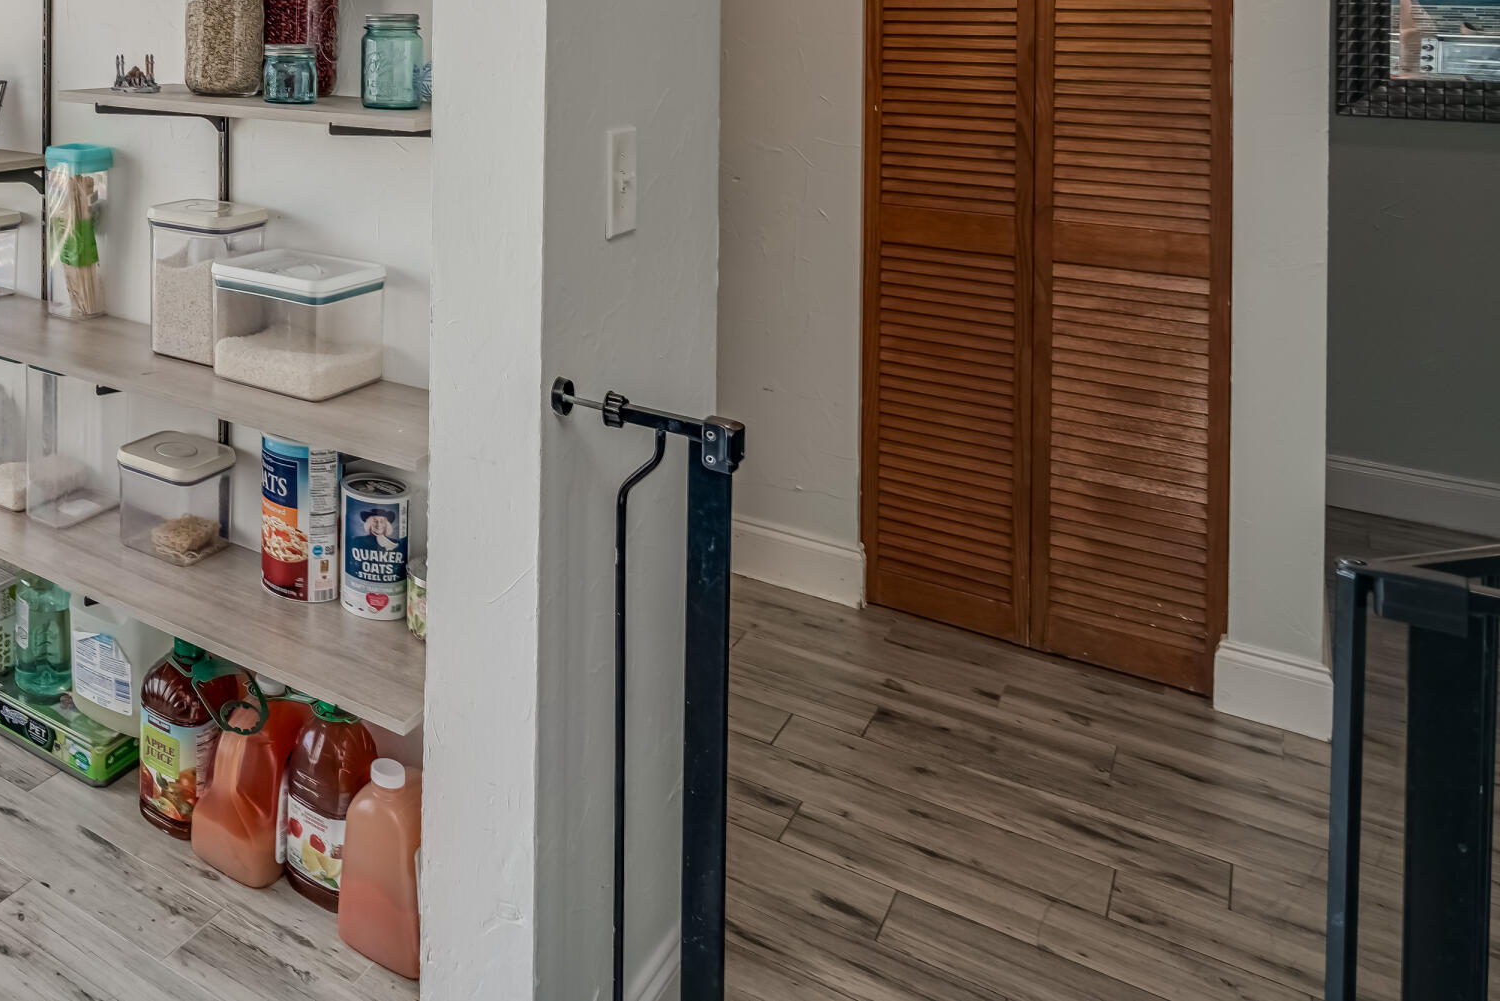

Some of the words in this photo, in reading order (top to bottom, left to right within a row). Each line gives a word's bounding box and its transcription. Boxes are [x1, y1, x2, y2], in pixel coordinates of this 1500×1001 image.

[261, 468, 288, 496] ATS
[351, 547, 403, 564] QUAKER
[358, 571, 381, 582] STEEL
[383, 574, 397, 582] CUT
[362, 562, 394, 575] OATS
[29, 721, 46, 738] PET
[146, 735, 175, 757] APPLE
[146, 744, 174, 766] JUICE
